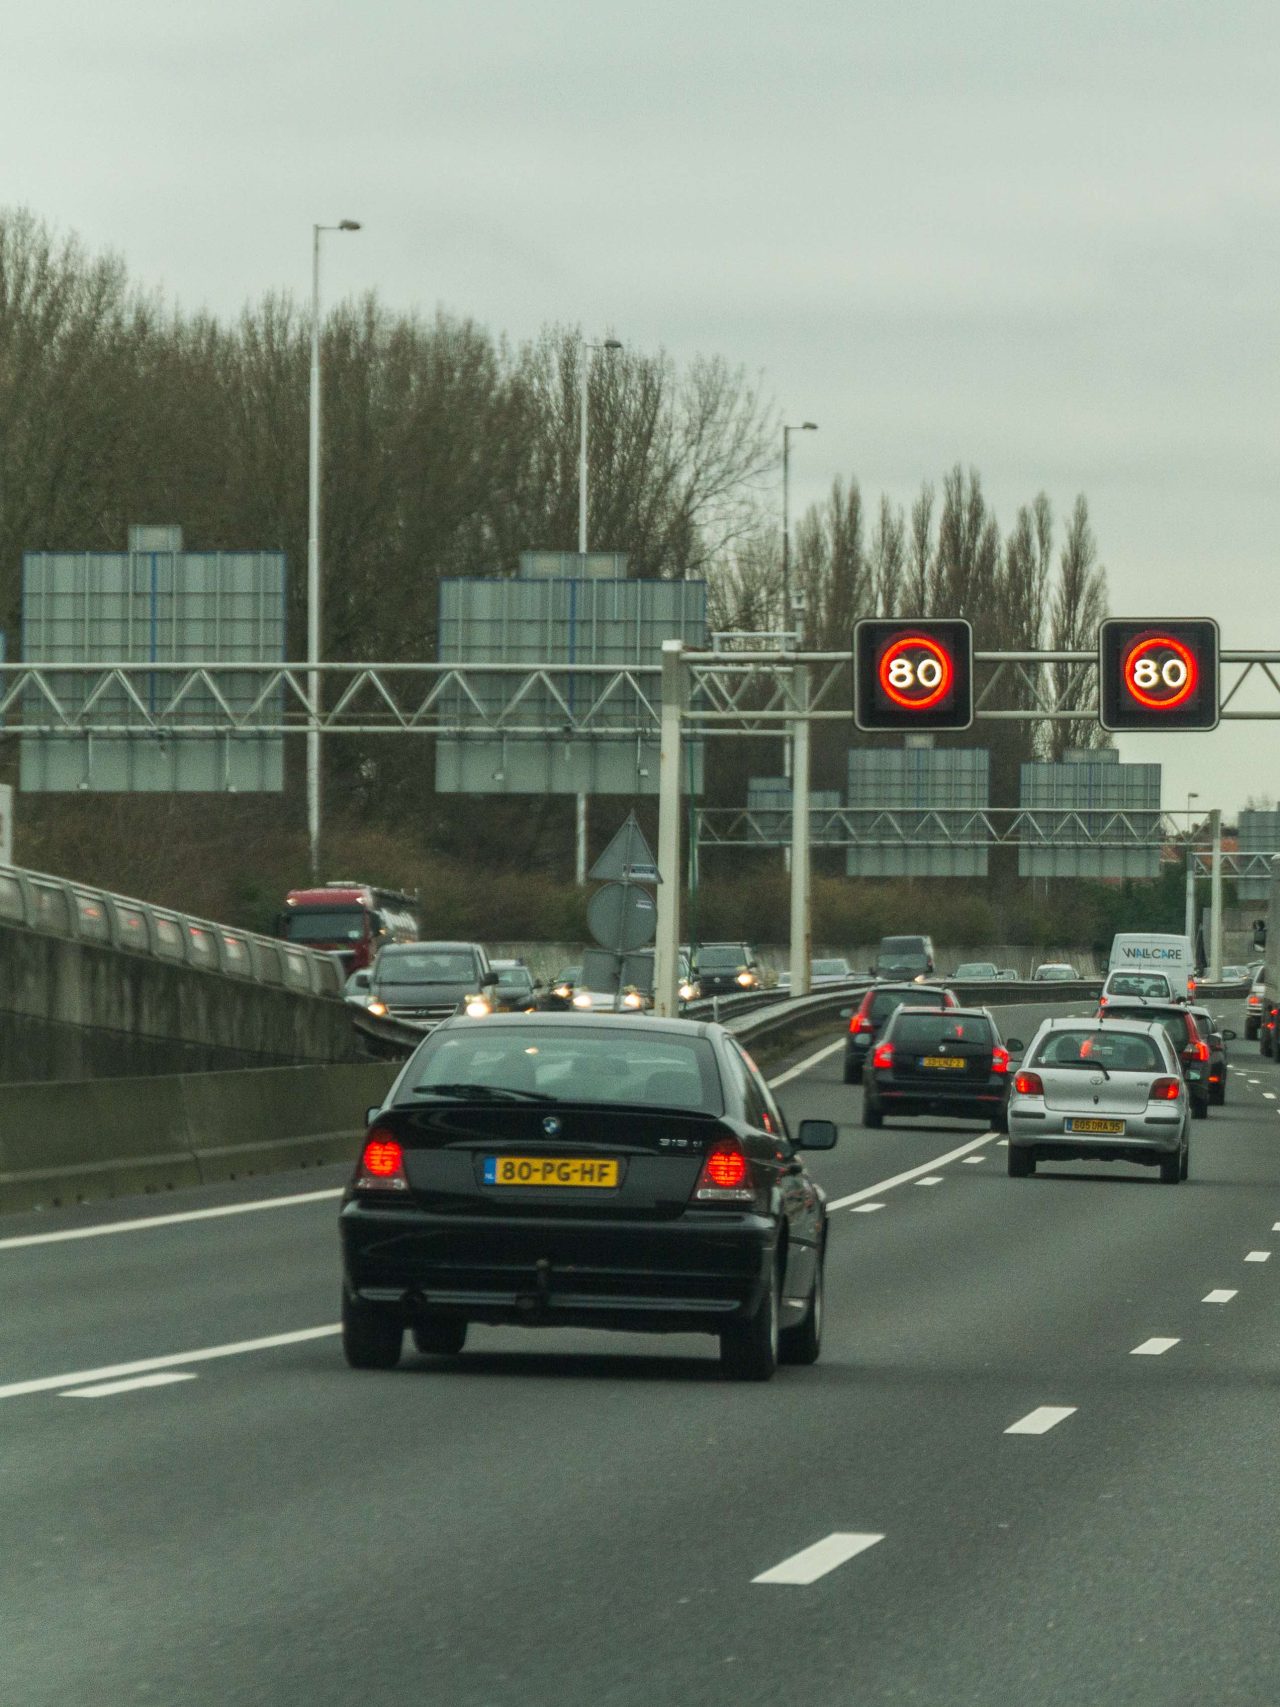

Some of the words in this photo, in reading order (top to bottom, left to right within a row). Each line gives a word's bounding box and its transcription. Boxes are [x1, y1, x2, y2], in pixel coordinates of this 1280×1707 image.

[888, 658, 942, 688] 80
[1133, 658, 1188, 688] 80
[1122, 947, 1183, 960] WALLCARE
[502, 1161, 611, 1183] 80-PG-HF
